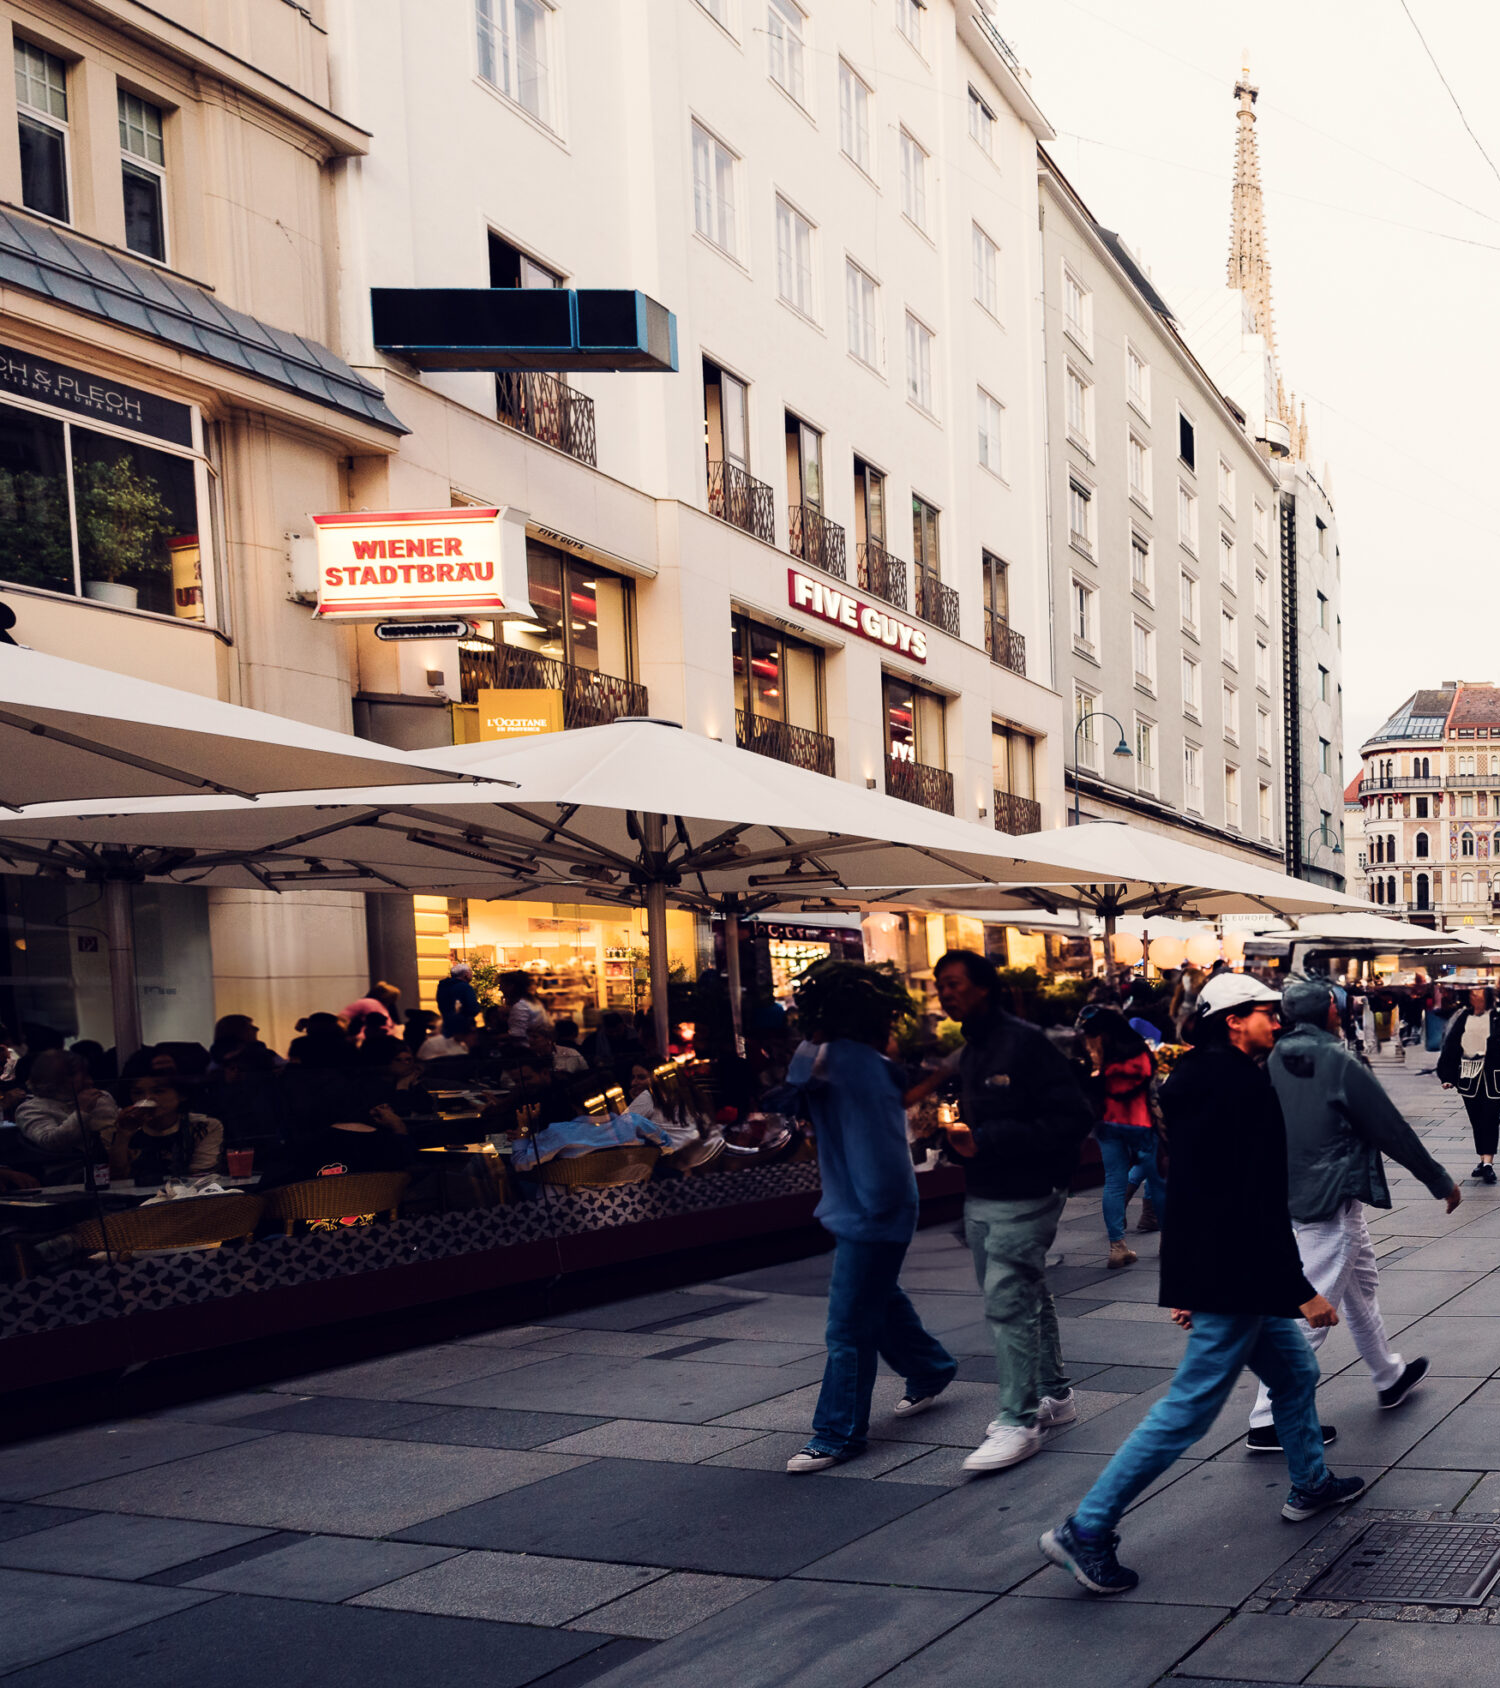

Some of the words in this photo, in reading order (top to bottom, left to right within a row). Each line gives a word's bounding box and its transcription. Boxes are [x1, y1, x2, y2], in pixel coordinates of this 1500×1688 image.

[33, 367, 52, 387] &
[58, 374, 142, 415] PLECH
[352, 537, 463, 560] WIENER
[537, 527, 560, 541] FIVE
[560, 534, 586, 551] GUYS
[325, 561, 495, 586] STADTBRÄU
[794, 574, 858, 629] FIVE
[861, 608, 927, 659] GUYS
